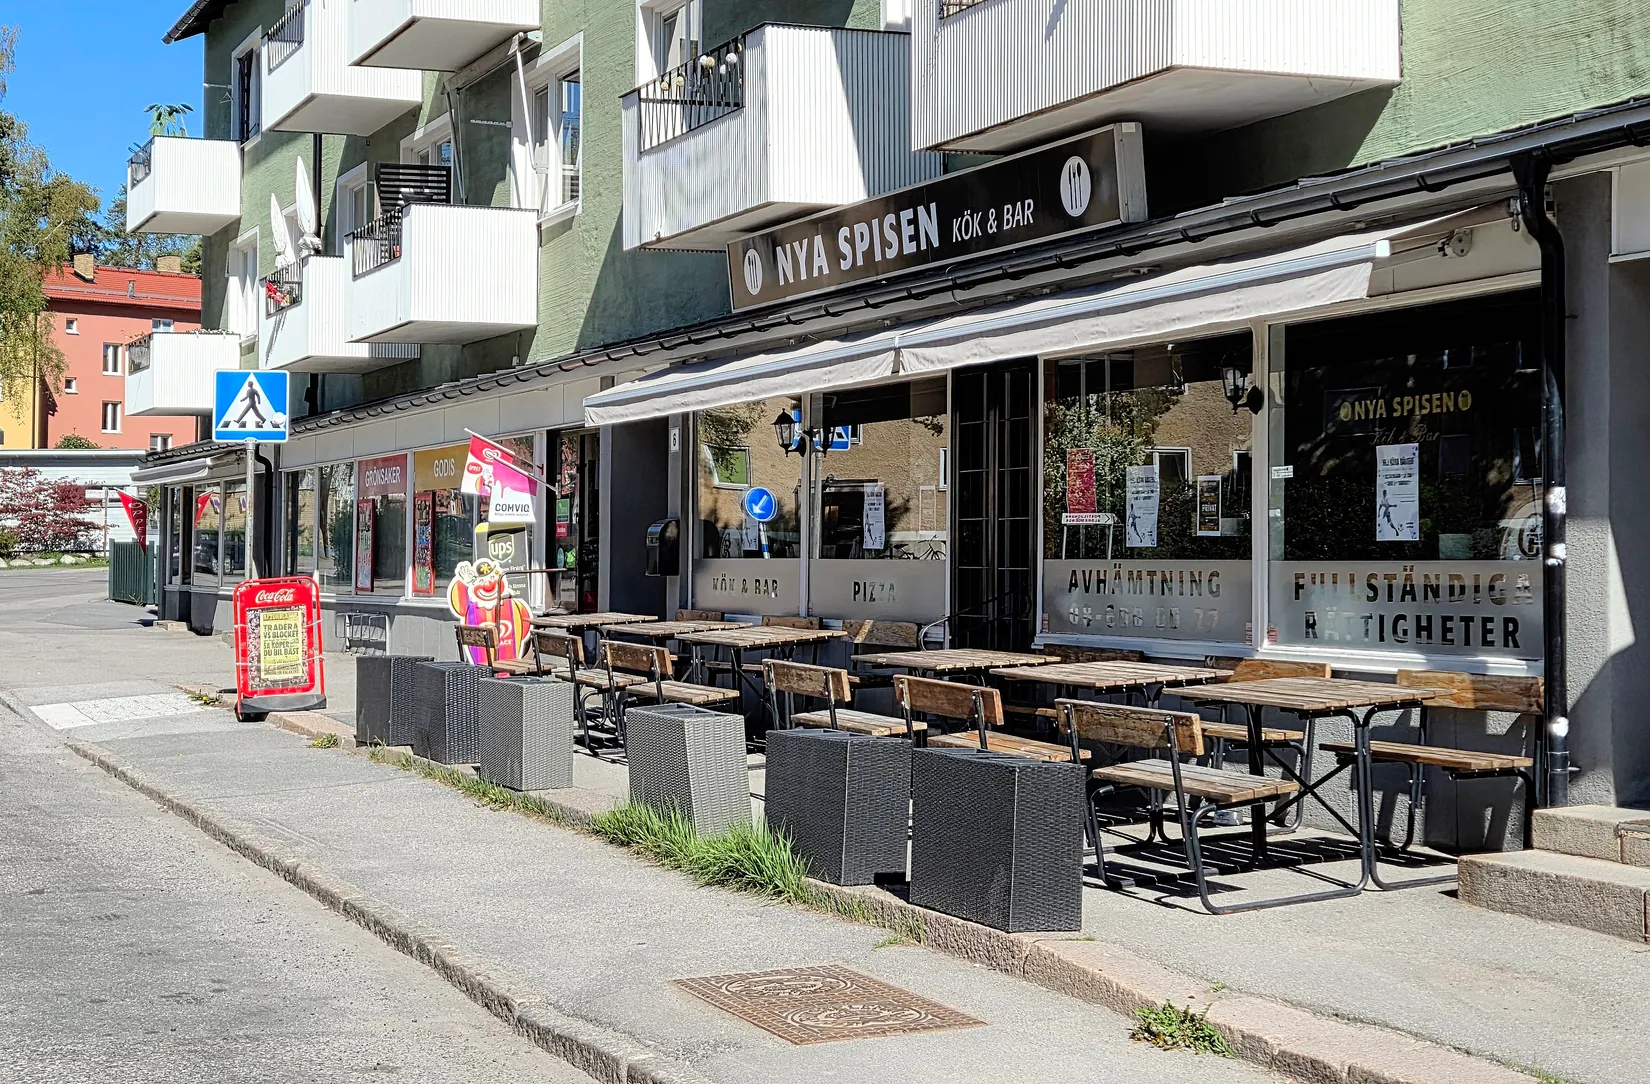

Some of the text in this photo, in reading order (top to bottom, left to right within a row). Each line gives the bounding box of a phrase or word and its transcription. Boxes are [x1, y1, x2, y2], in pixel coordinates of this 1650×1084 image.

[776, 198, 1034, 286] NYA SPISEN KÖK & BAR
[1354, 391, 1454, 420] NYA SPISEN
[672, 433, 677, 446] 6
[365, 465, 401, 487] GRÖNSAKER
[433, 458, 455, 478] GODIS
[494, 503, 530, 513] COMVIQ
[491, 541, 513, 559] ups
[741, 578, 749, 594] &
[754, 578, 779, 598] BAR
[1068, 563, 1221, 598] AVHÄMTNING
[255, 588, 295, 604] Coca-Cola
[853, 581, 896, 602] PIZZA
[263, 623, 298, 631] TRADERA
[263, 631, 299, 639] VS BLOCKET
[263, 649, 272, 657] DU
[274, 648, 283, 656] BIL
